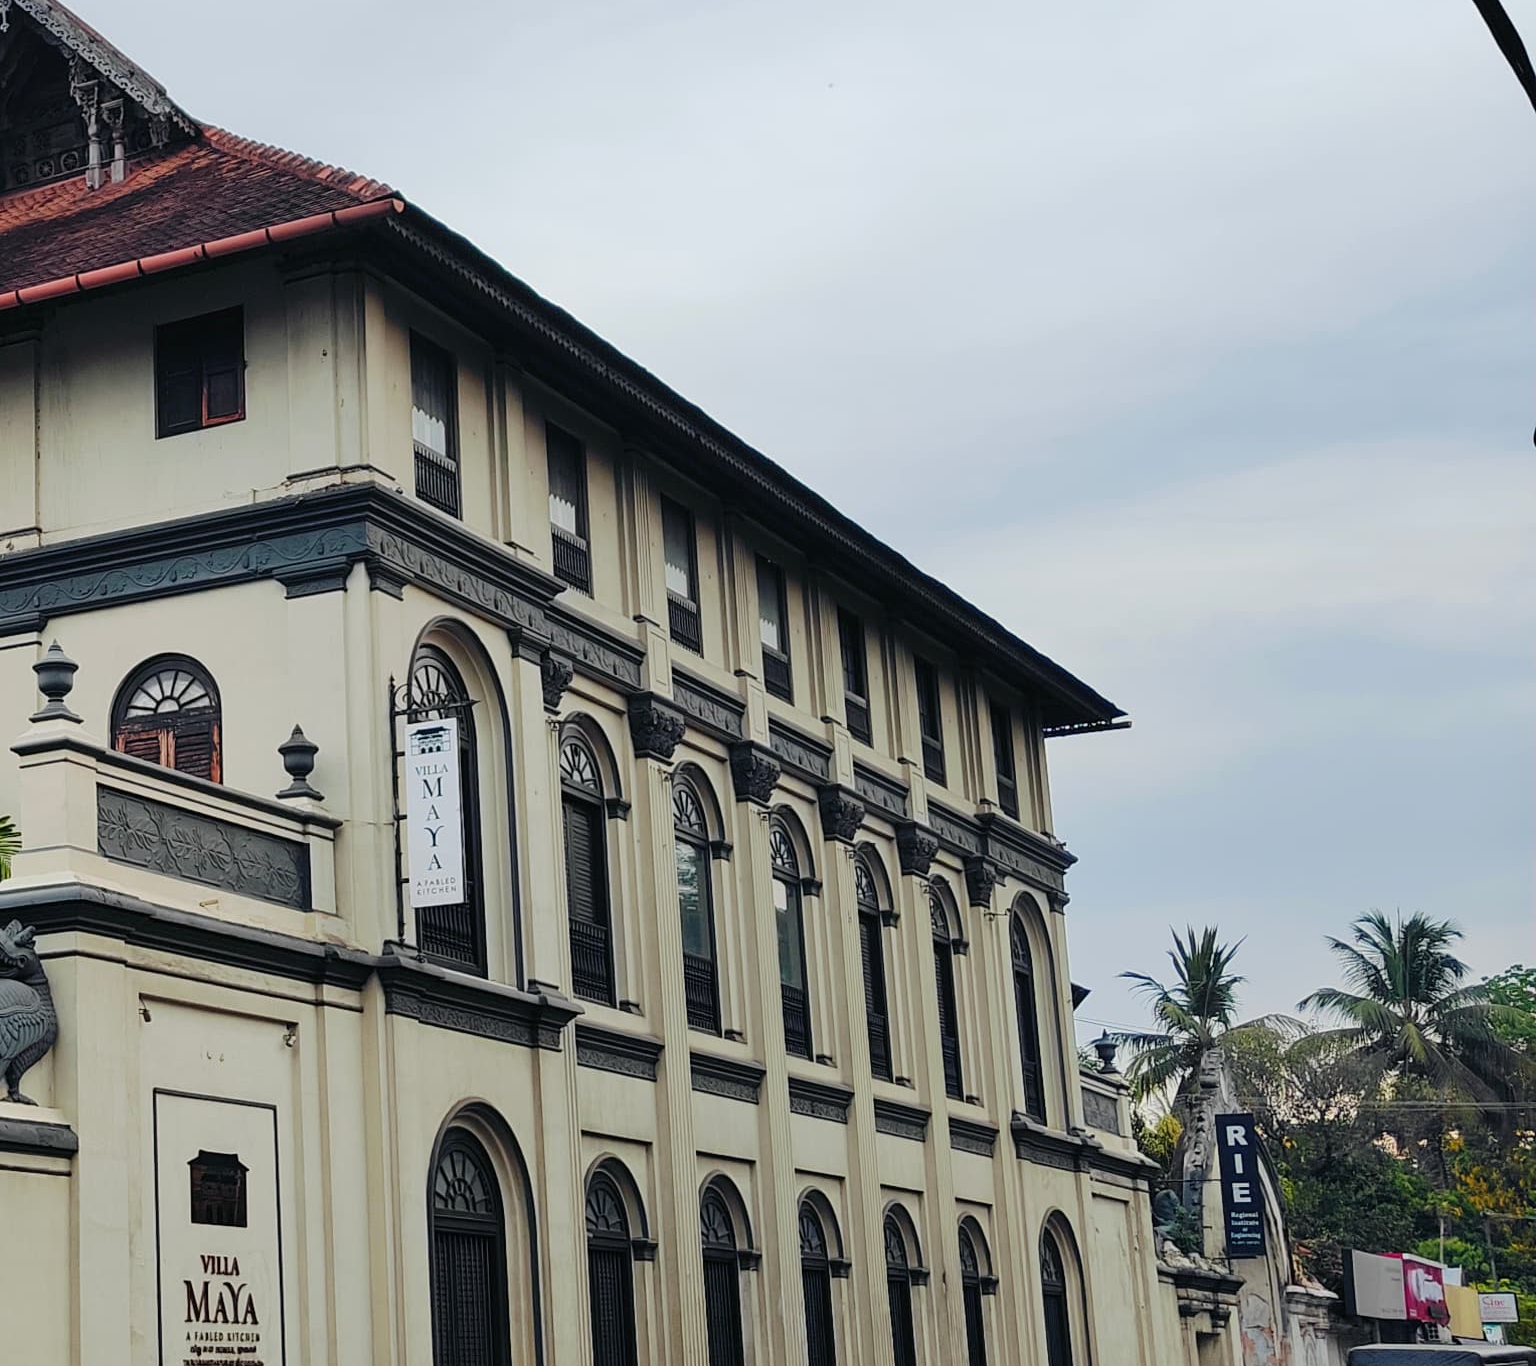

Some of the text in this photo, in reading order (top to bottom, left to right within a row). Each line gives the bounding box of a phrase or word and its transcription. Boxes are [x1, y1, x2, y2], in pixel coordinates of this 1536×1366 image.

[415, 764, 449, 776] VILLA
[422, 777, 444, 871] MAYA
[424, 877, 456, 886] FABLED
[417, 885, 457, 895] KITCHEN
[1231, 1211, 1258, 1219] Regional
[200, 1254, 240, 1276] VILLA
[183, 1279, 259, 1325] MAYA
[194, 1331, 224, 1342] FABLED
[227, 1332, 260, 1343] KITCHEN
